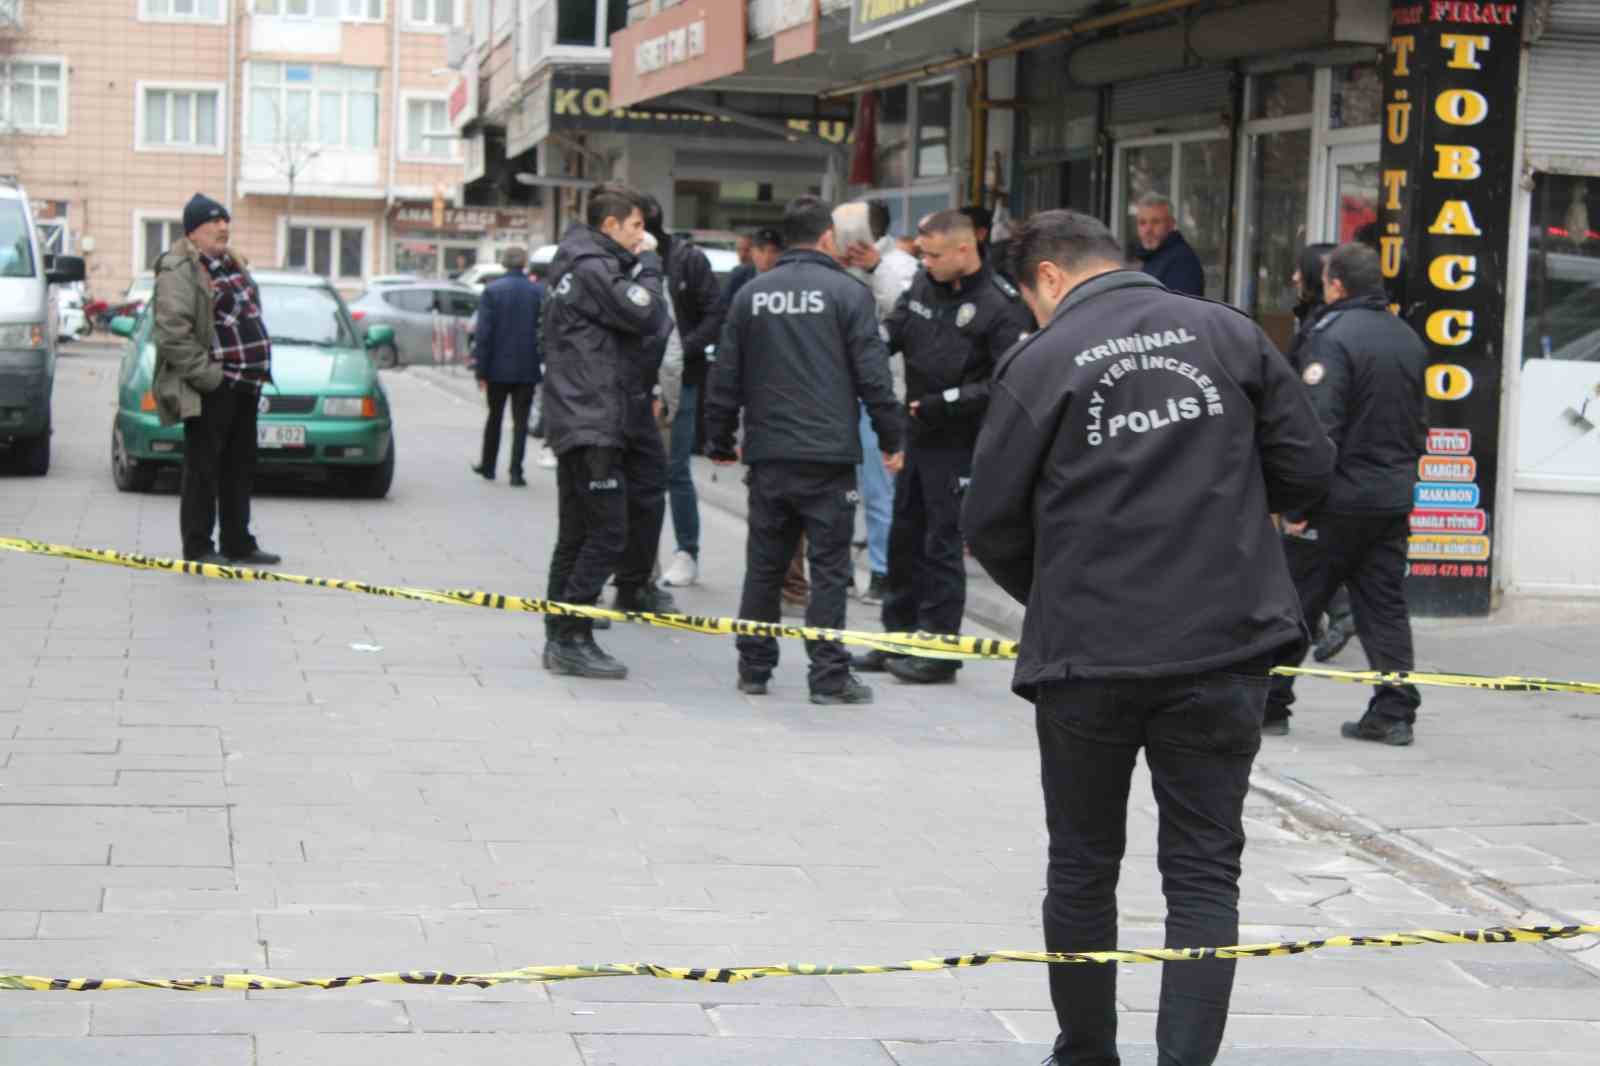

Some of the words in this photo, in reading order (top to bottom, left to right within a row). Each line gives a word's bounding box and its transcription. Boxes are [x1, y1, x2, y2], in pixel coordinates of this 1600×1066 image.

[1427, 0, 1517, 25] FIRAT
[1380, 35, 1415, 316] TÜTÜ
[1424, 33, 1491, 401] TOBACCO
[752, 289, 825, 317] POLİS
[1074, 327, 1197, 367] KRİMİNAL
[1086, 389, 1105, 447] OLAY
[1099, 353, 1139, 388] YERİ
[1140, 353, 1225, 417] İNCELEME
[1107, 395, 1202, 438] POLİS
